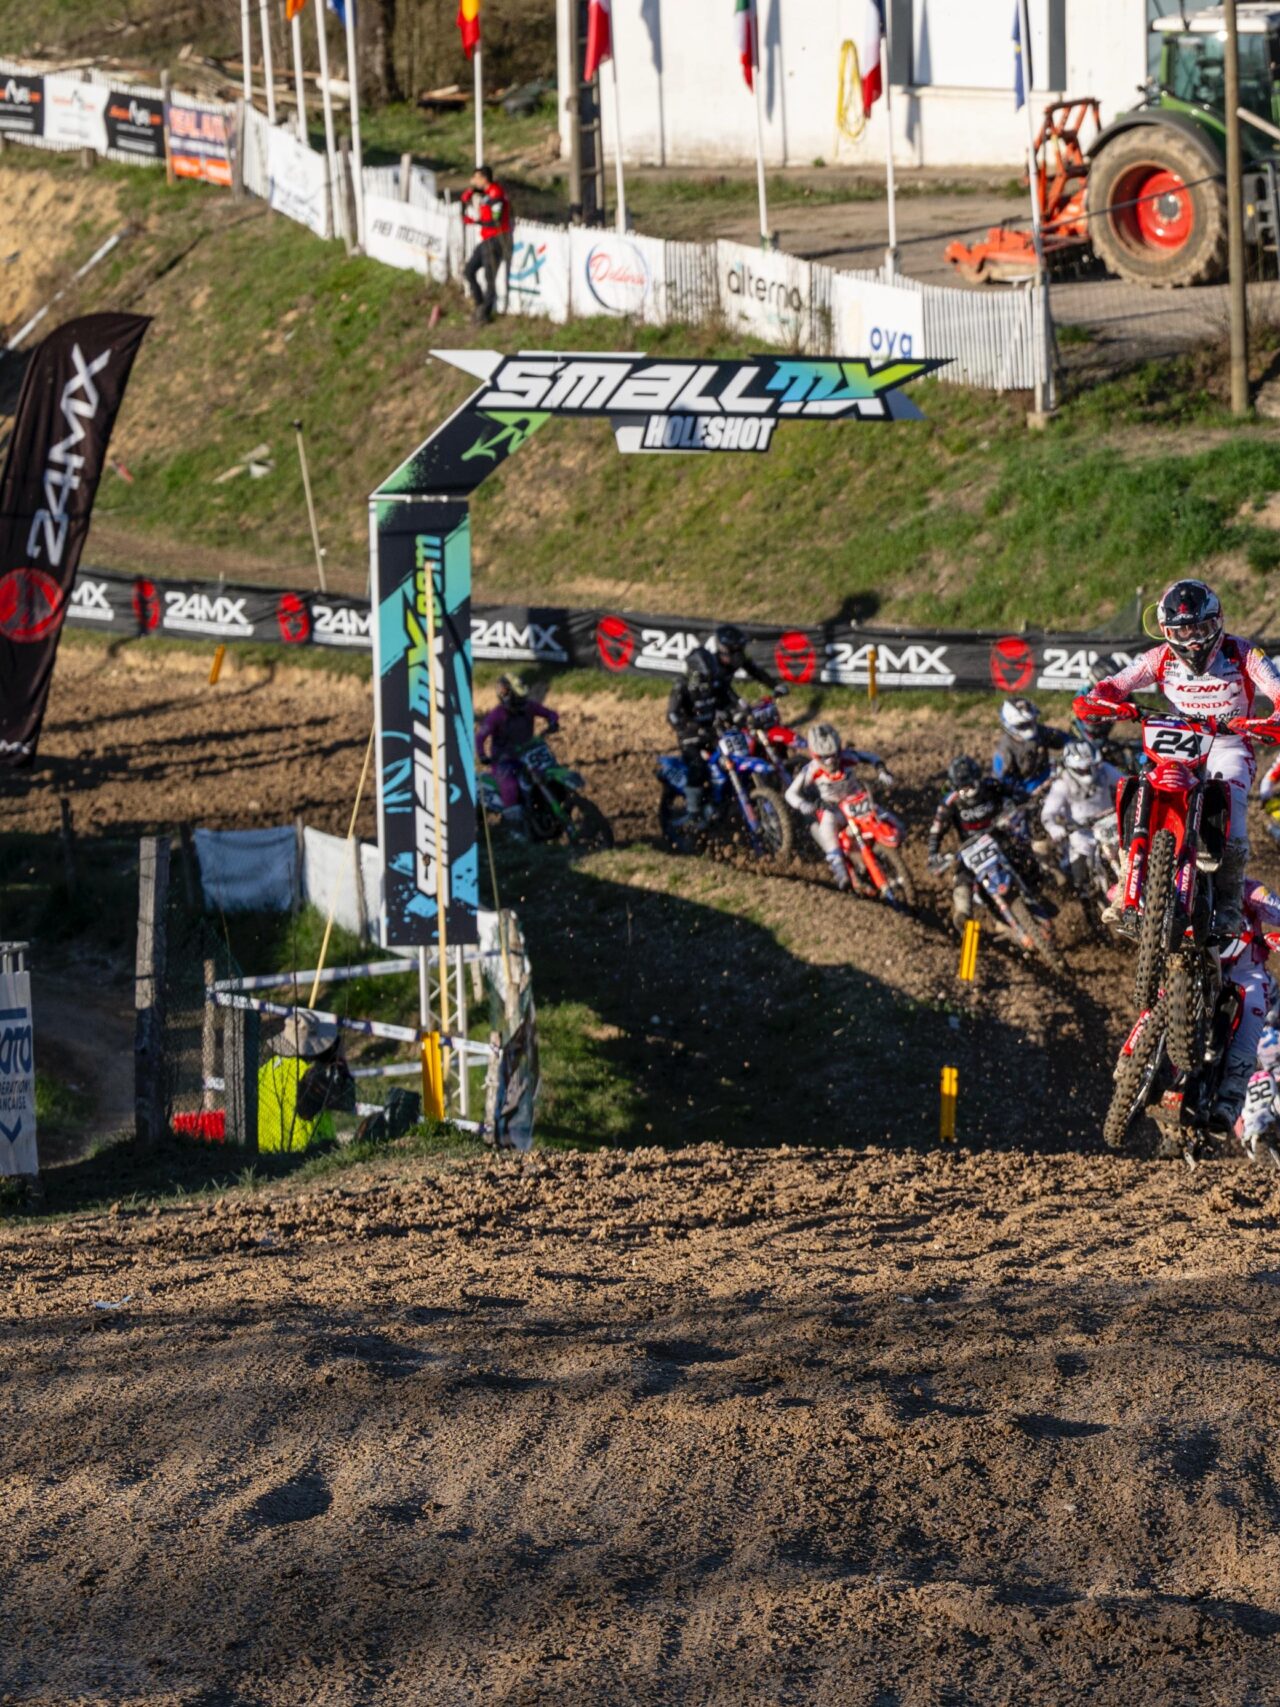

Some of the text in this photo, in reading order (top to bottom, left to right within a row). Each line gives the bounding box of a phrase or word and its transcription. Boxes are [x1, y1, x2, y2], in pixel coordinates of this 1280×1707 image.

[643, 414, 776, 450] HOLESHOT
[27, 343, 112, 566] 24MX
[164, 591, 251, 625] 24MX
[312, 605, 372, 636] 24M
[470, 618, 563, 651] 24MX
[825, 643, 951, 675] 24MX
[1176, 682, 1231, 693] KENNY
[1180, 700, 1232, 709] HONDA
[1151, 729, 1204, 758] 24
[0, 1025, 32, 1075] OTO
[1248, 1080, 1271, 1103] 52
